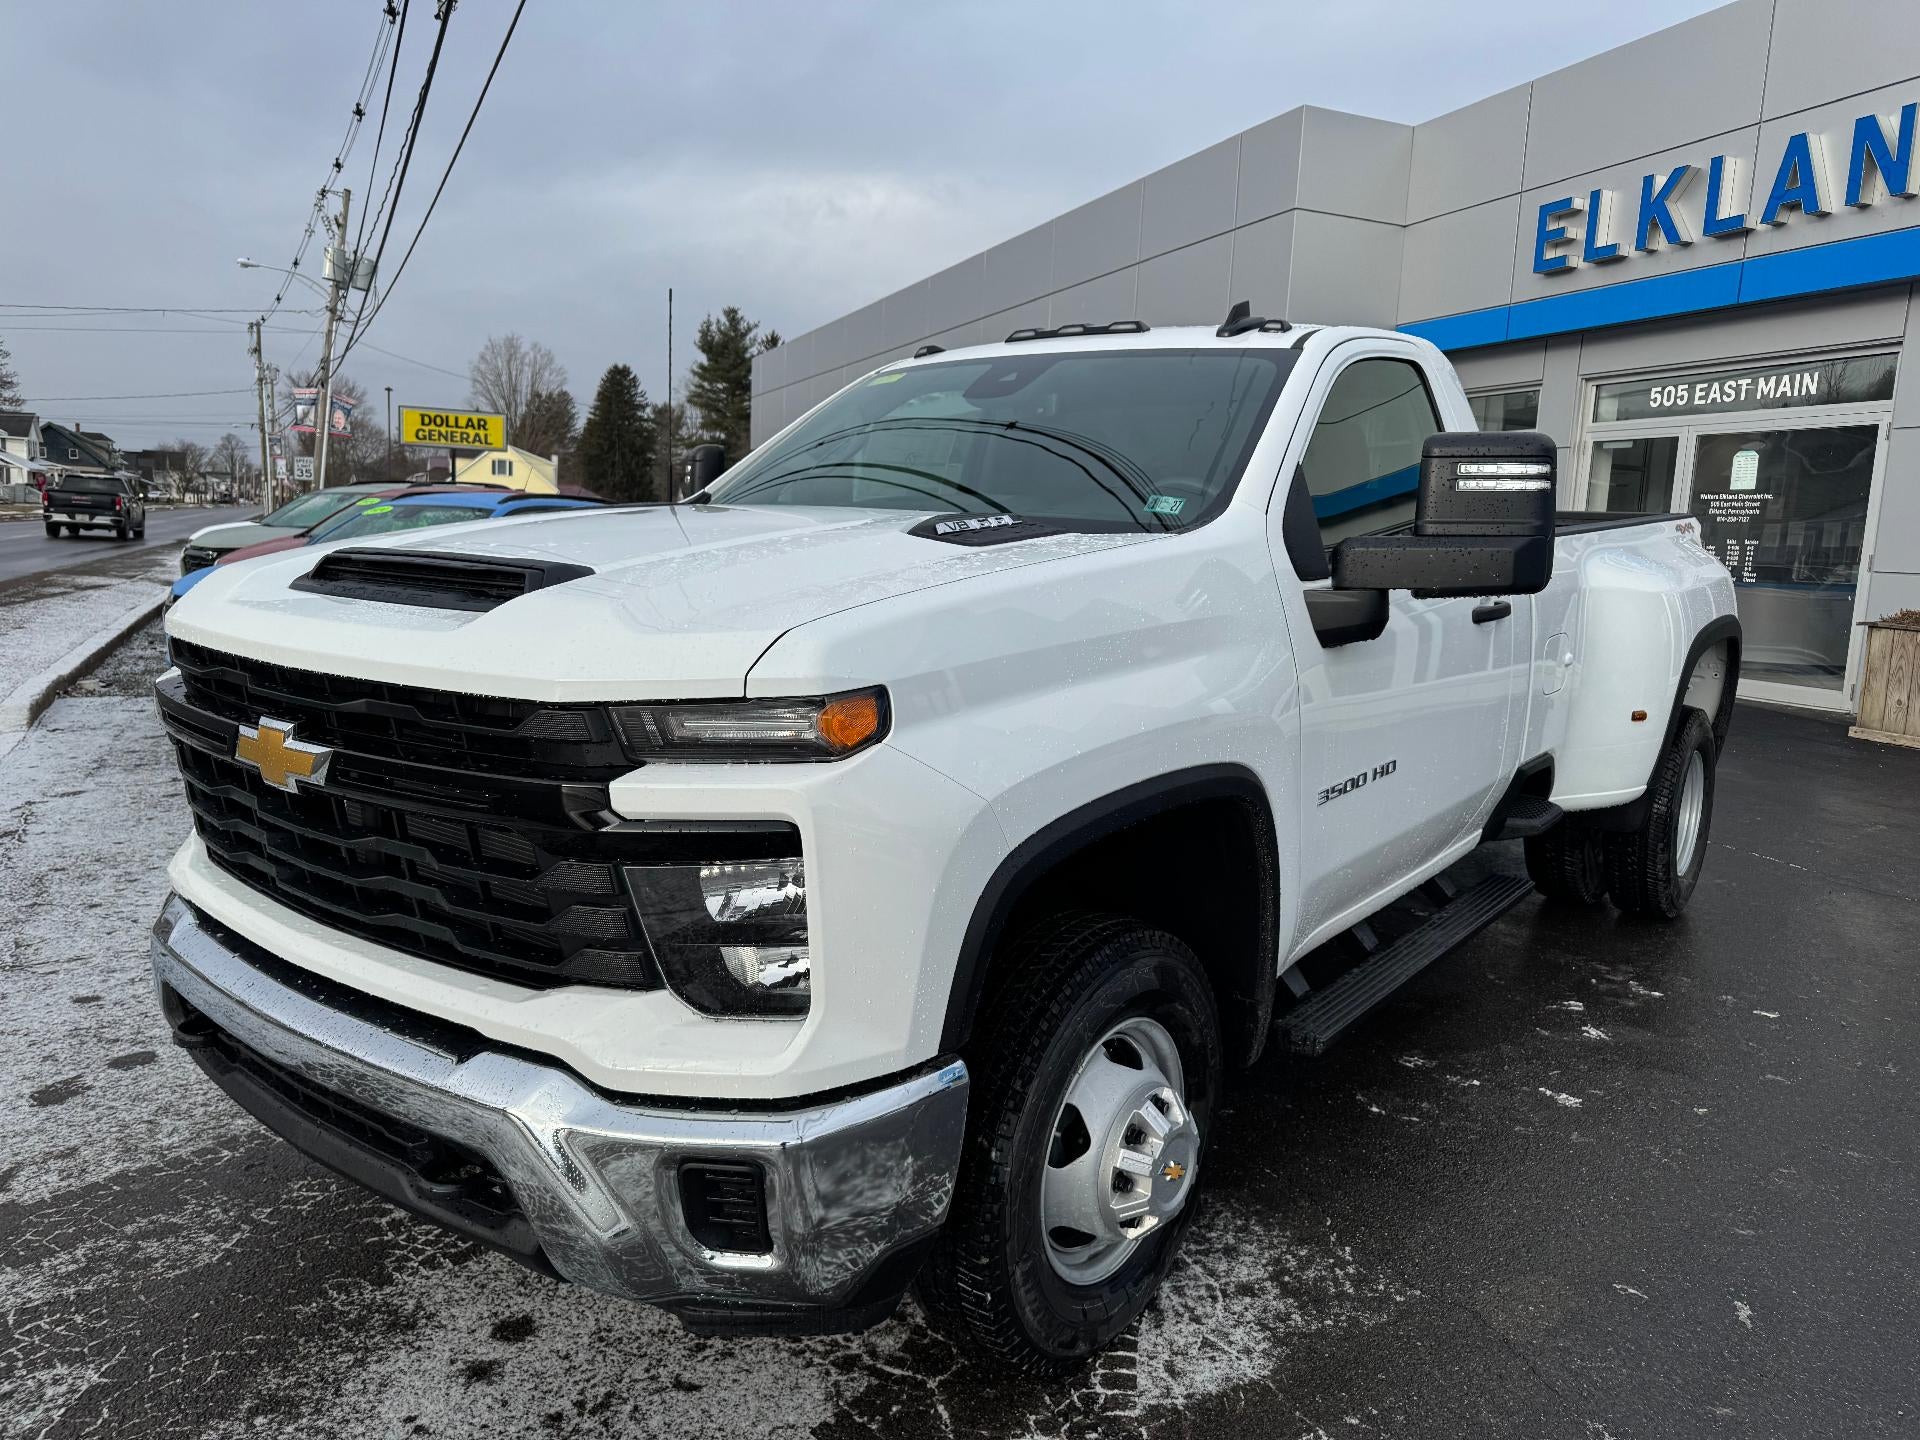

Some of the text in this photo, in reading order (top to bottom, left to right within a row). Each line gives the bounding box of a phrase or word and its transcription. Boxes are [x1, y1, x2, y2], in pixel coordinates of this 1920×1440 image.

[1532, 101, 1920, 275] ELKLAN
[1649, 371, 1819, 408] 505 EAST MAIN
[419, 413, 489, 431] DOLLAR
[414, 428, 494, 446] GENERAL
[297, 467, 312, 478] 35
[1169, 500, 1183, 512] 27
[1316, 759, 1397, 807] 3500 HD
